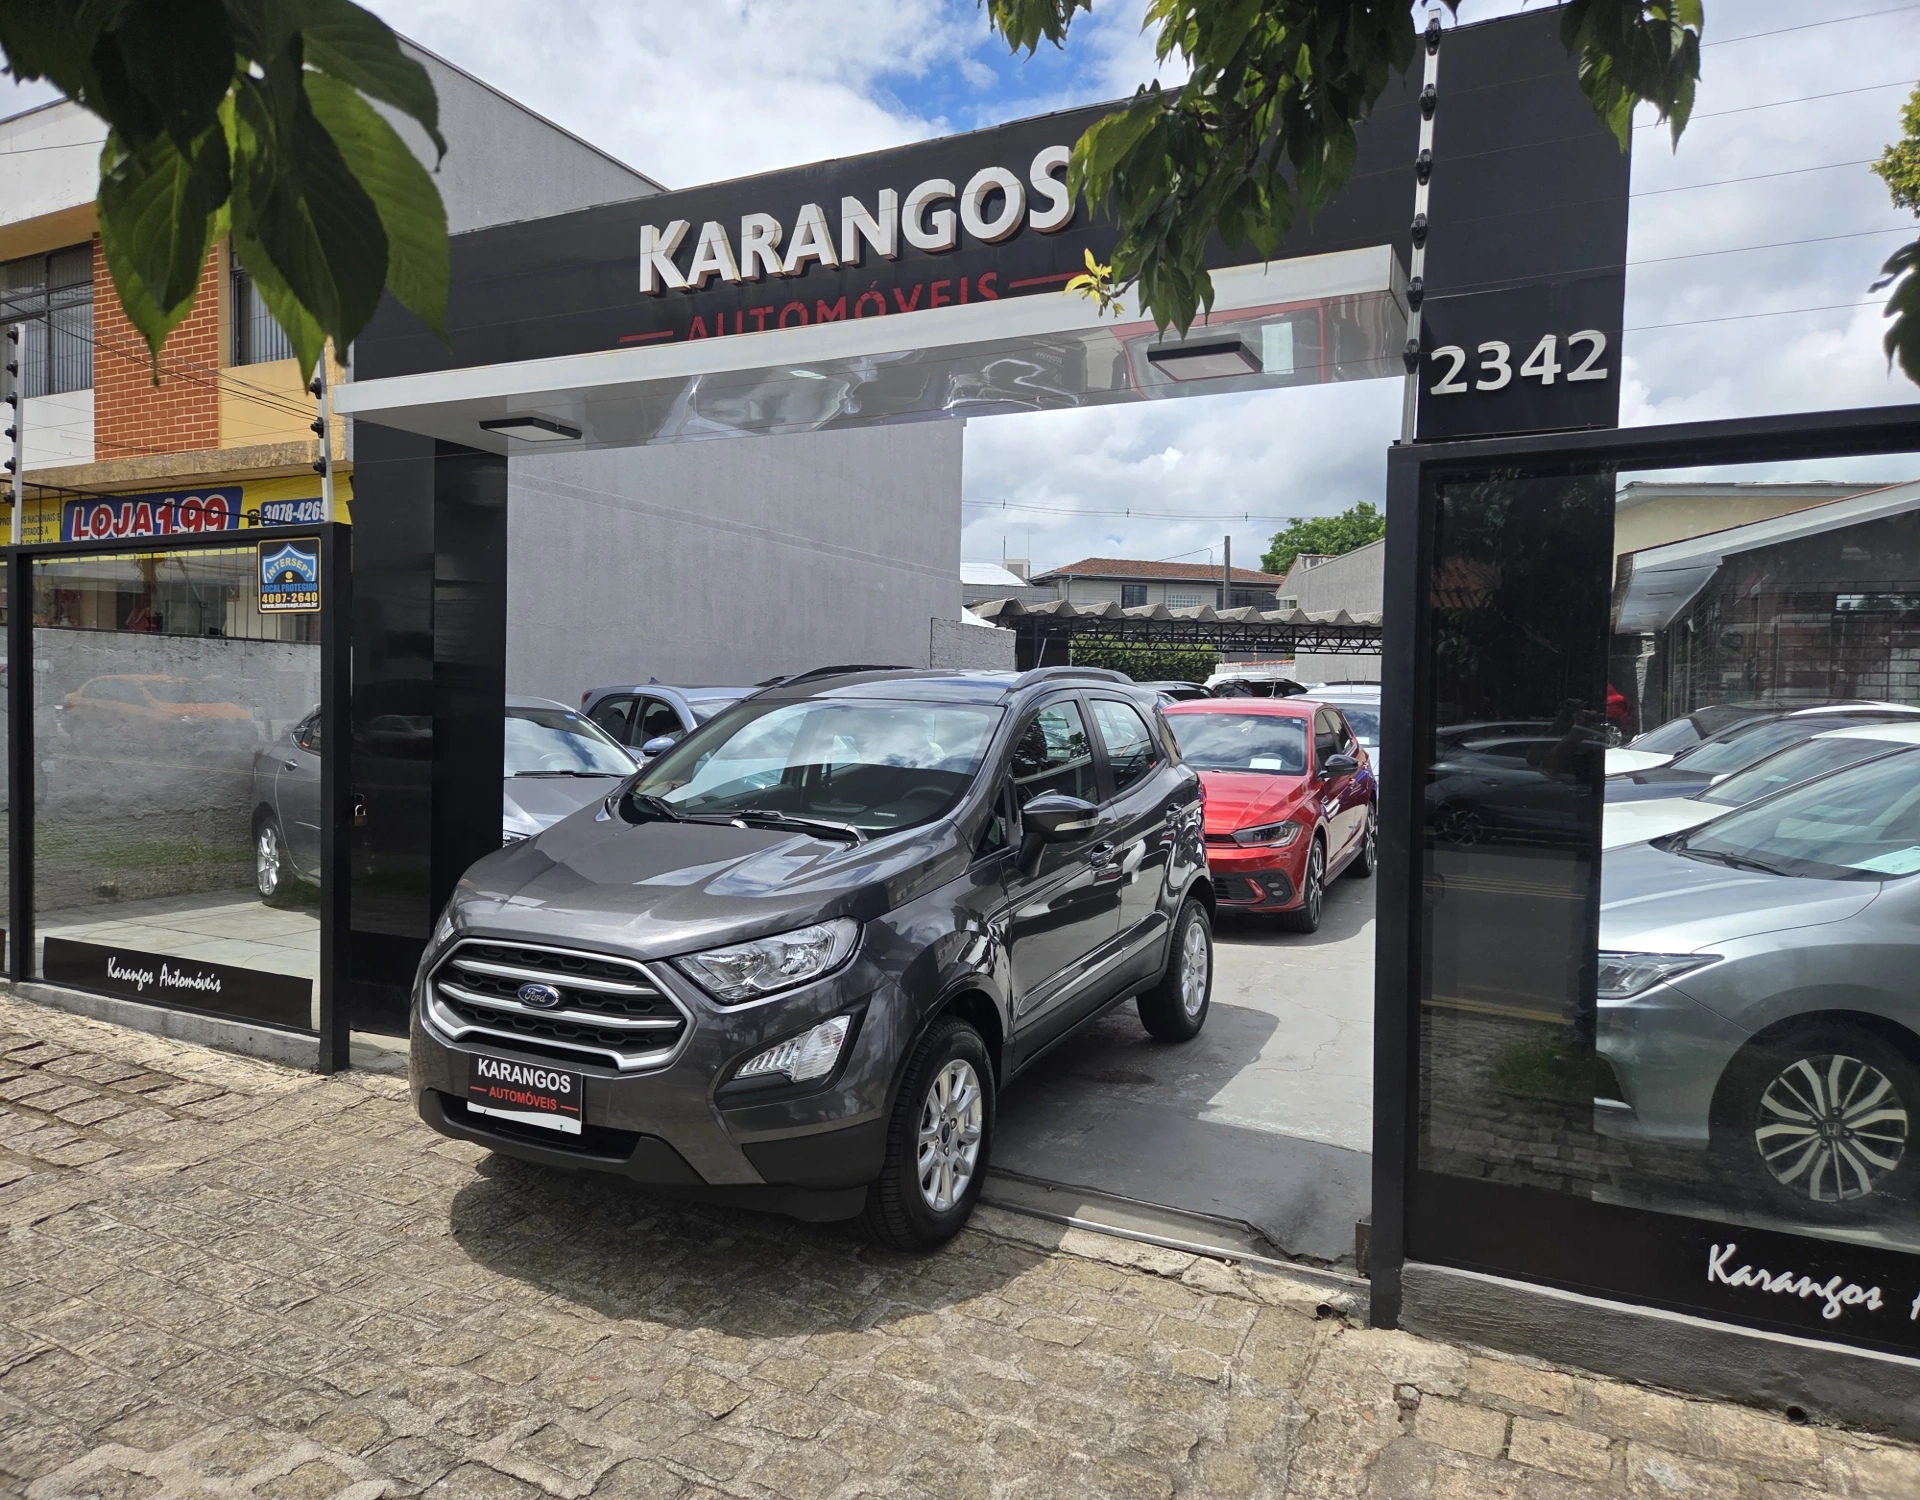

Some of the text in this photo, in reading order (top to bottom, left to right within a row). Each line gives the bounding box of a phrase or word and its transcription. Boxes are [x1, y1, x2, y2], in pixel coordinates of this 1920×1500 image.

[639, 145, 1075, 295] KARANGOS
[1430, 329, 1608, 395] 2342
[72, 502, 153, 541] LOJA
[266, 557, 313, 580] INTERSEPT
[262, 582, 318, 593] LOCAL PROTEGIDO
[262, 592, 318, 603] 4007-2640
[107, 956, 222, 993] Karangos Automóveis
[477, 1058, 571, 1094] KARANGOS
[488, 1085, 557, 1111] AUTOMÓVEIS
[1707, 1243, 1884, 1320] Karangos
